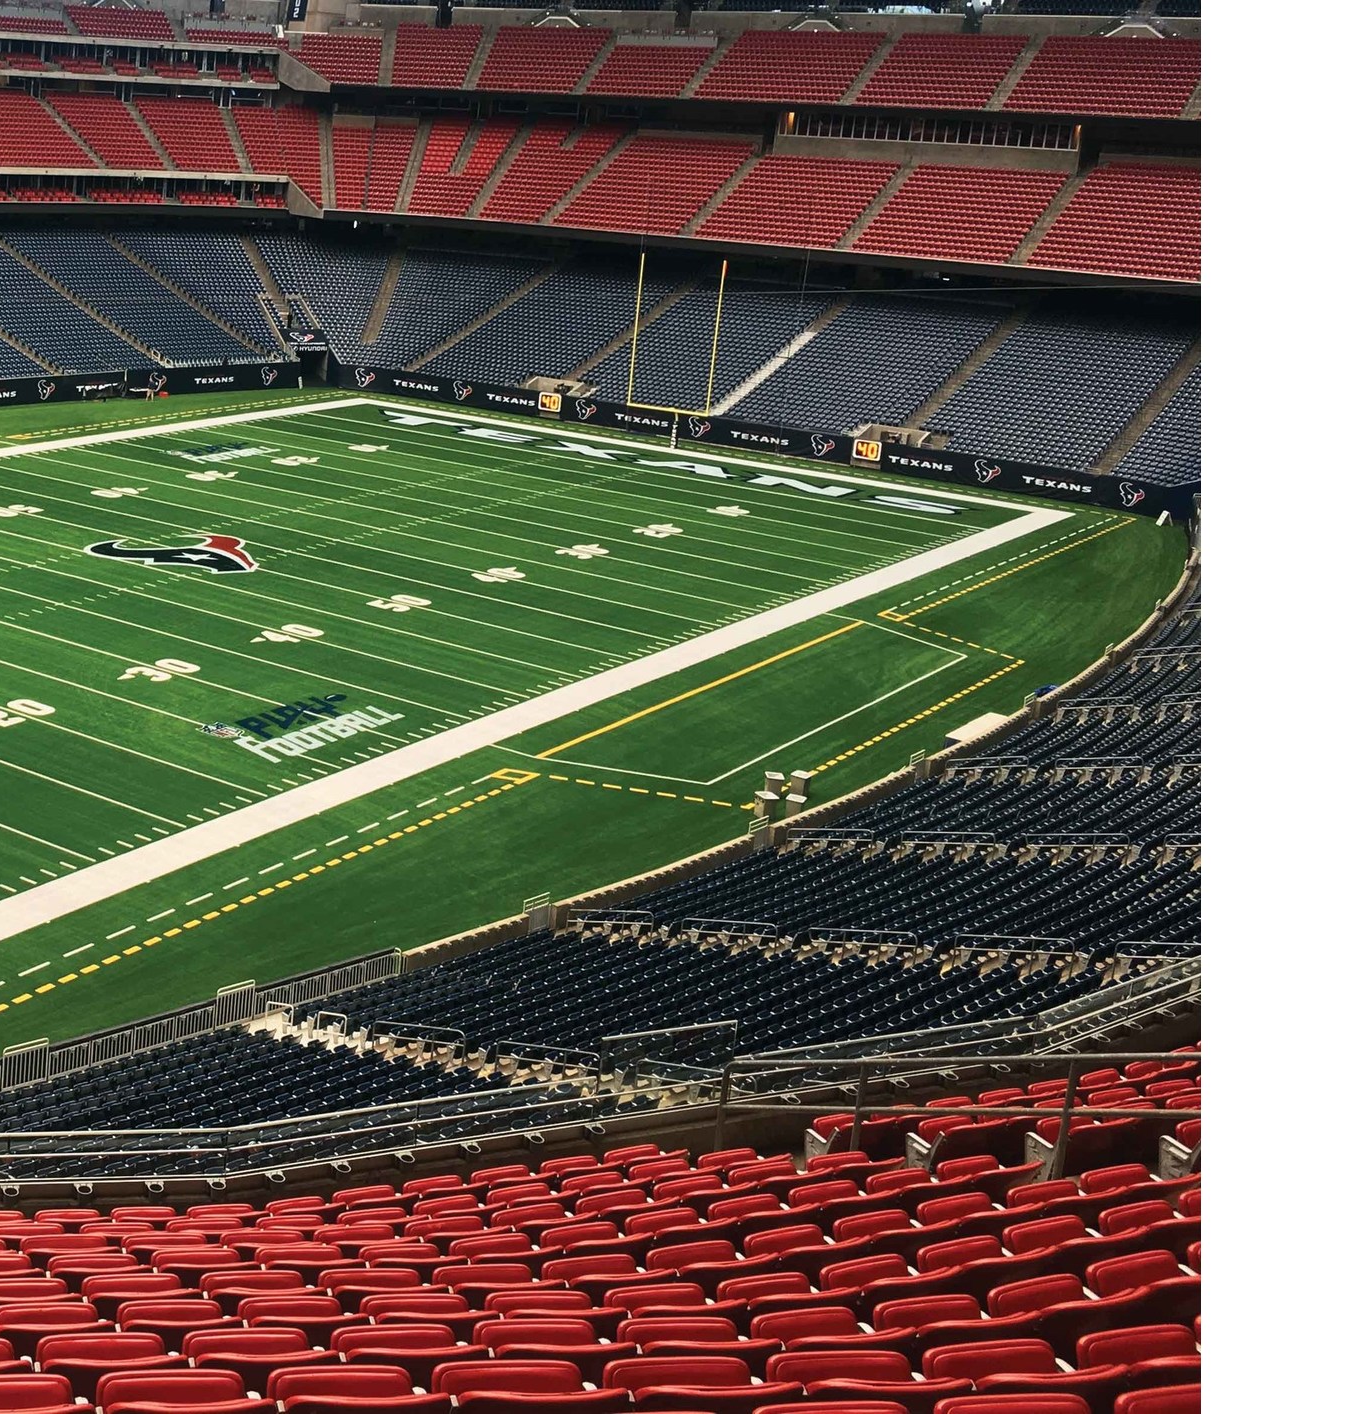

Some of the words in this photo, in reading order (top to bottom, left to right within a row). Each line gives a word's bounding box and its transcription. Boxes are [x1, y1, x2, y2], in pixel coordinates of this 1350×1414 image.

[193, 376, 234, 384] TEXANS
[393, 379, 439, 392] TEXANS
[486, 393, 536, 407] TEXANS
[541, 395, 559, 410] 40
[614, 412, 669, 427] TEXANS
[730, 430, 790, 446] TEXANS
[857, 442, 879, 459] 40
[377, 409, 972, 516] TEXANS
[888, 455, 953, 472] TEXANS
[1021, 475, 1092, 493] TEXANS
[366, 594, 432, 612] 50
[265, 623, 325, 643] 40
[132, 658, 201, 682] 30
[234, 695, 343, 740] PLAY
[232, 705, 406, 764] FOOTBALL
